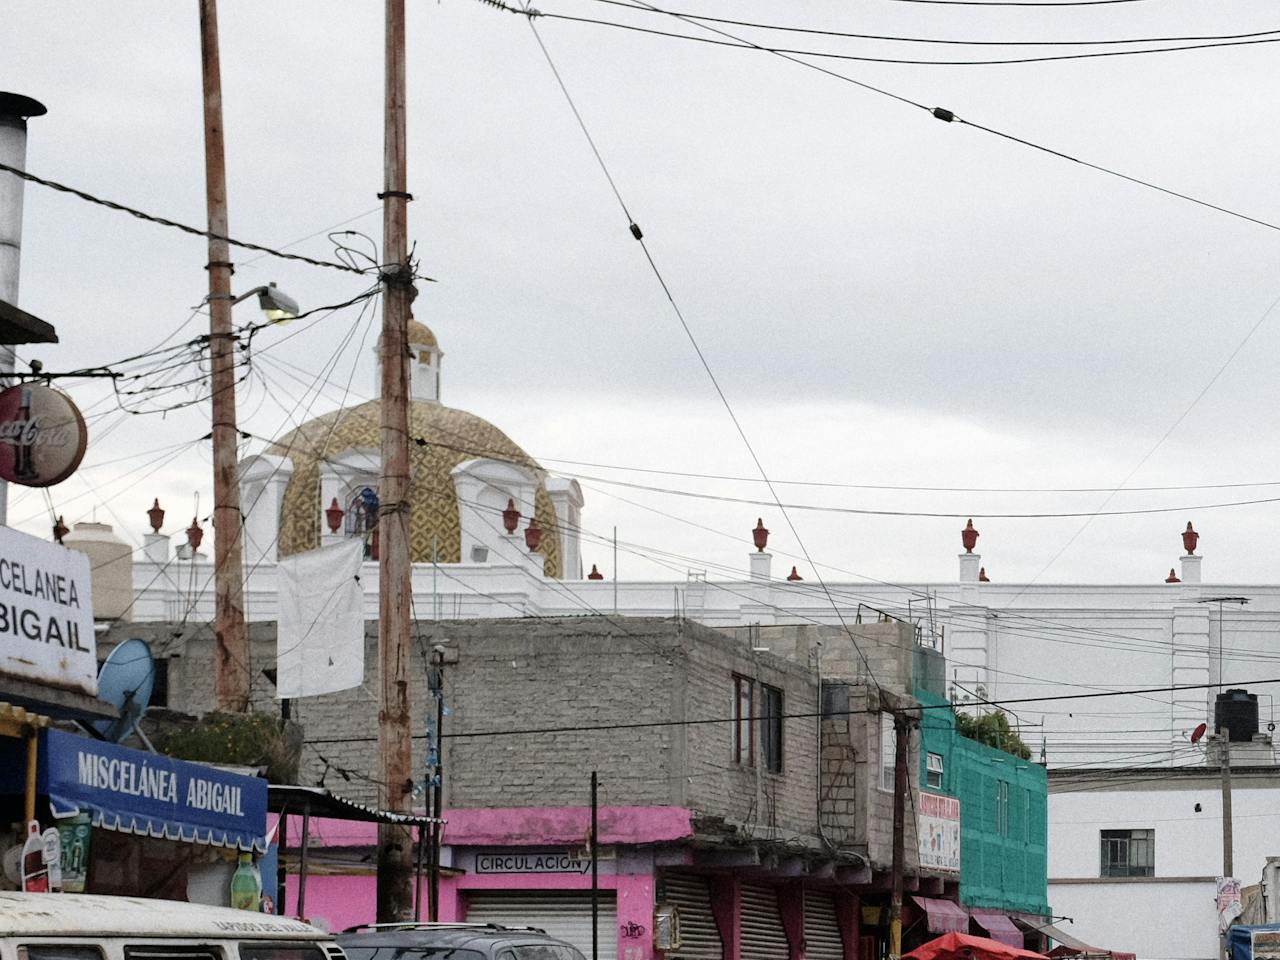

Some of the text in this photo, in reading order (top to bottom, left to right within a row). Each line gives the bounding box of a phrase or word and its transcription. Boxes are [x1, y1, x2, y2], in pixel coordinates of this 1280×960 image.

[0, 558, 80, 609] CELANEA
[0, 602, 90, 653] BIGAIL
[78, 751, 245, 817] MISCELÁNEA ABIGAIL
